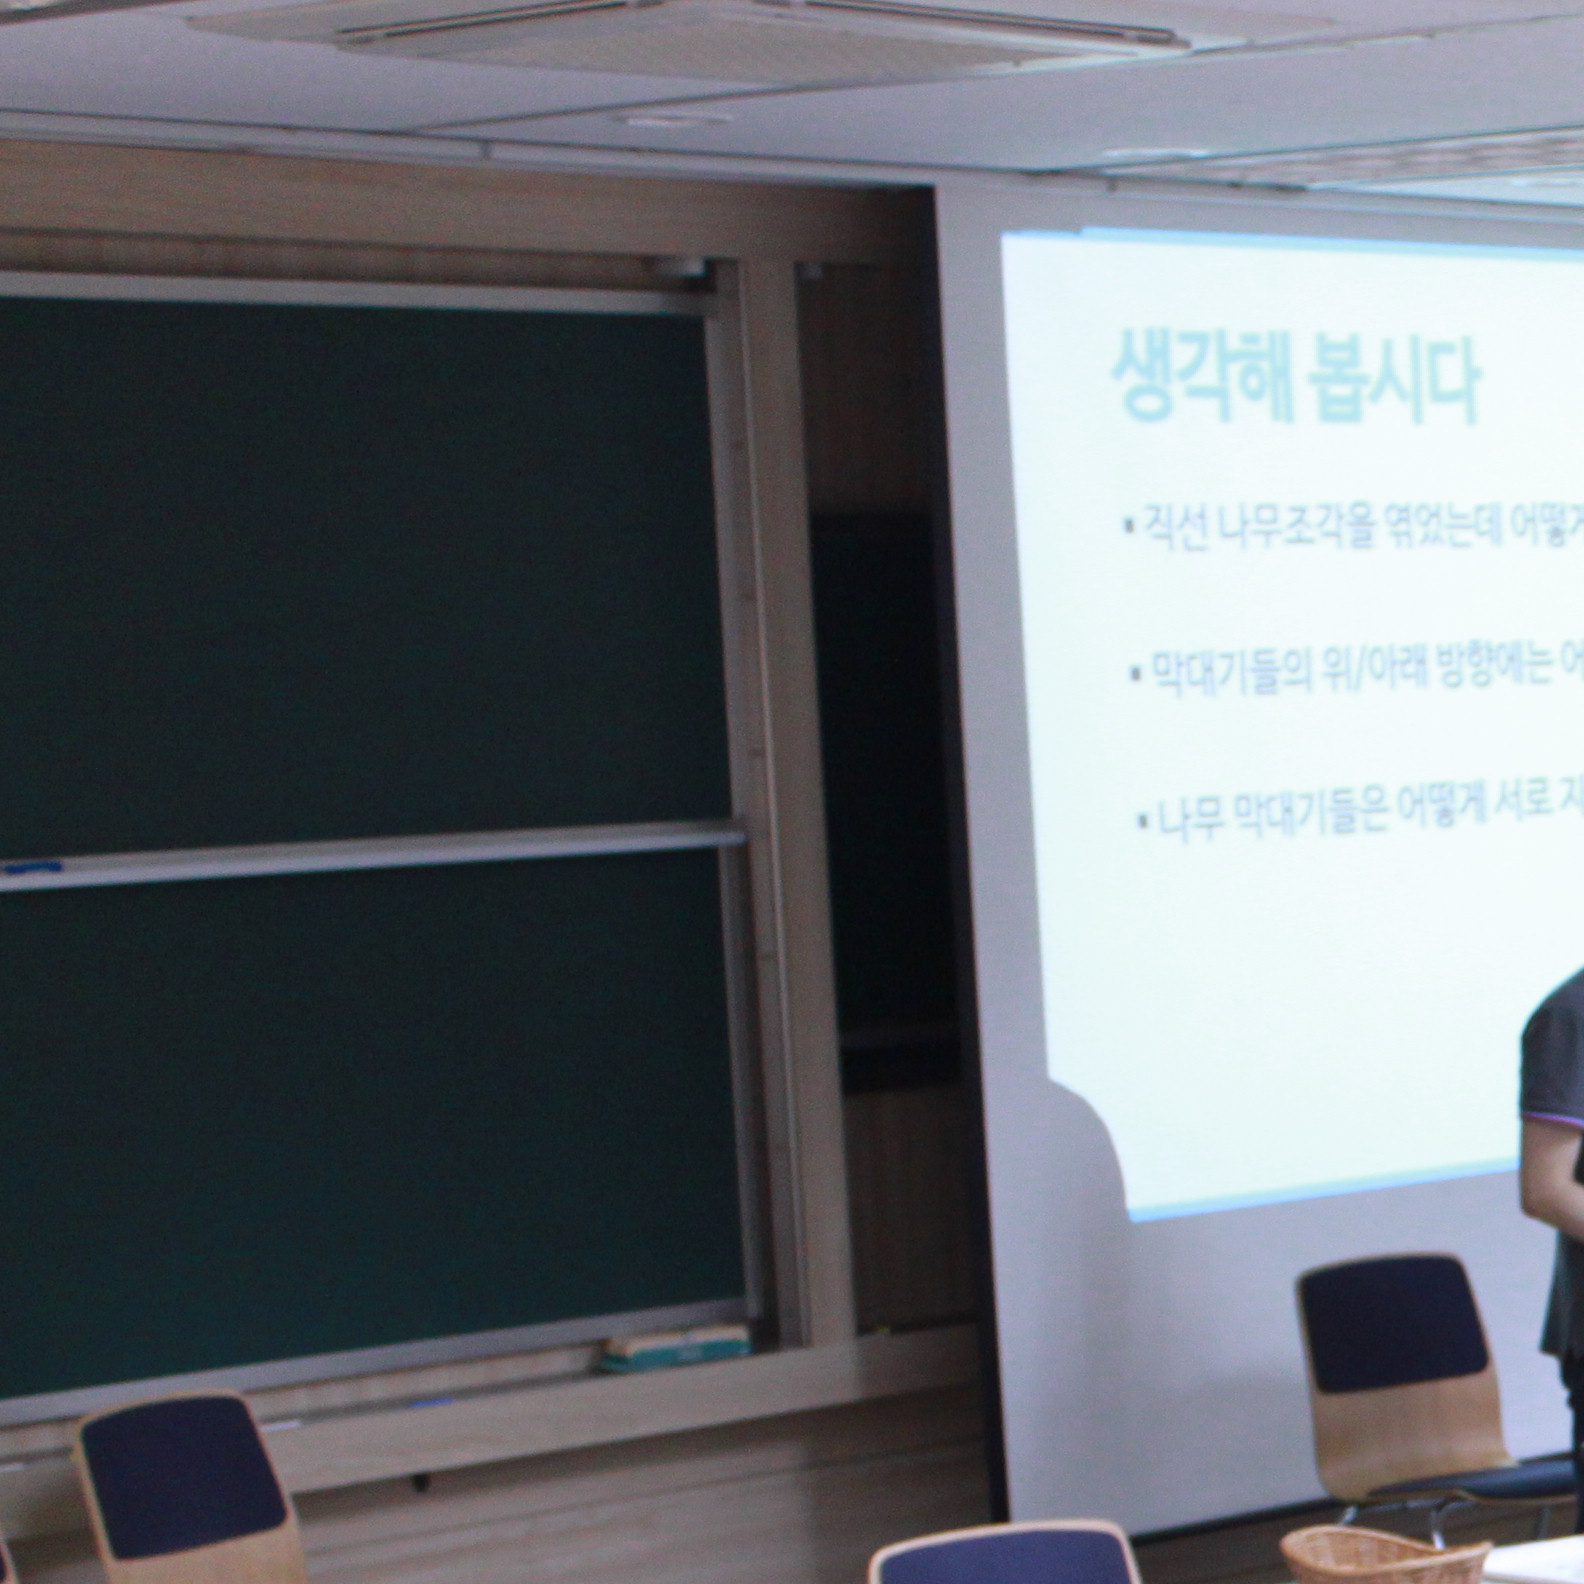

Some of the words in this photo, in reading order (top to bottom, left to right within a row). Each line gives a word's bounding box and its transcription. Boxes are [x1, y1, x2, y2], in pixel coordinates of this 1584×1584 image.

[1108, 325, 1297, 426] 생각해
[1305, 331, 1485, 428] 봅시다
[1145, 501, 1209, 553] 직선
[1219, 499, 1376, 552] 나무조각을
[1151, 644, 1314, 700] 막대기들의
[1322, 641, 1430, 693] 위/아래
[1435, 638, 1554, 689] 방향에는
[1157, 794, 1227, 844] 나무
[1234, 782, 1391, 837] 막대기들은
[1396, 778, 1489, 827] 어떻게
[1495, 775, 1554, 823] 서로
